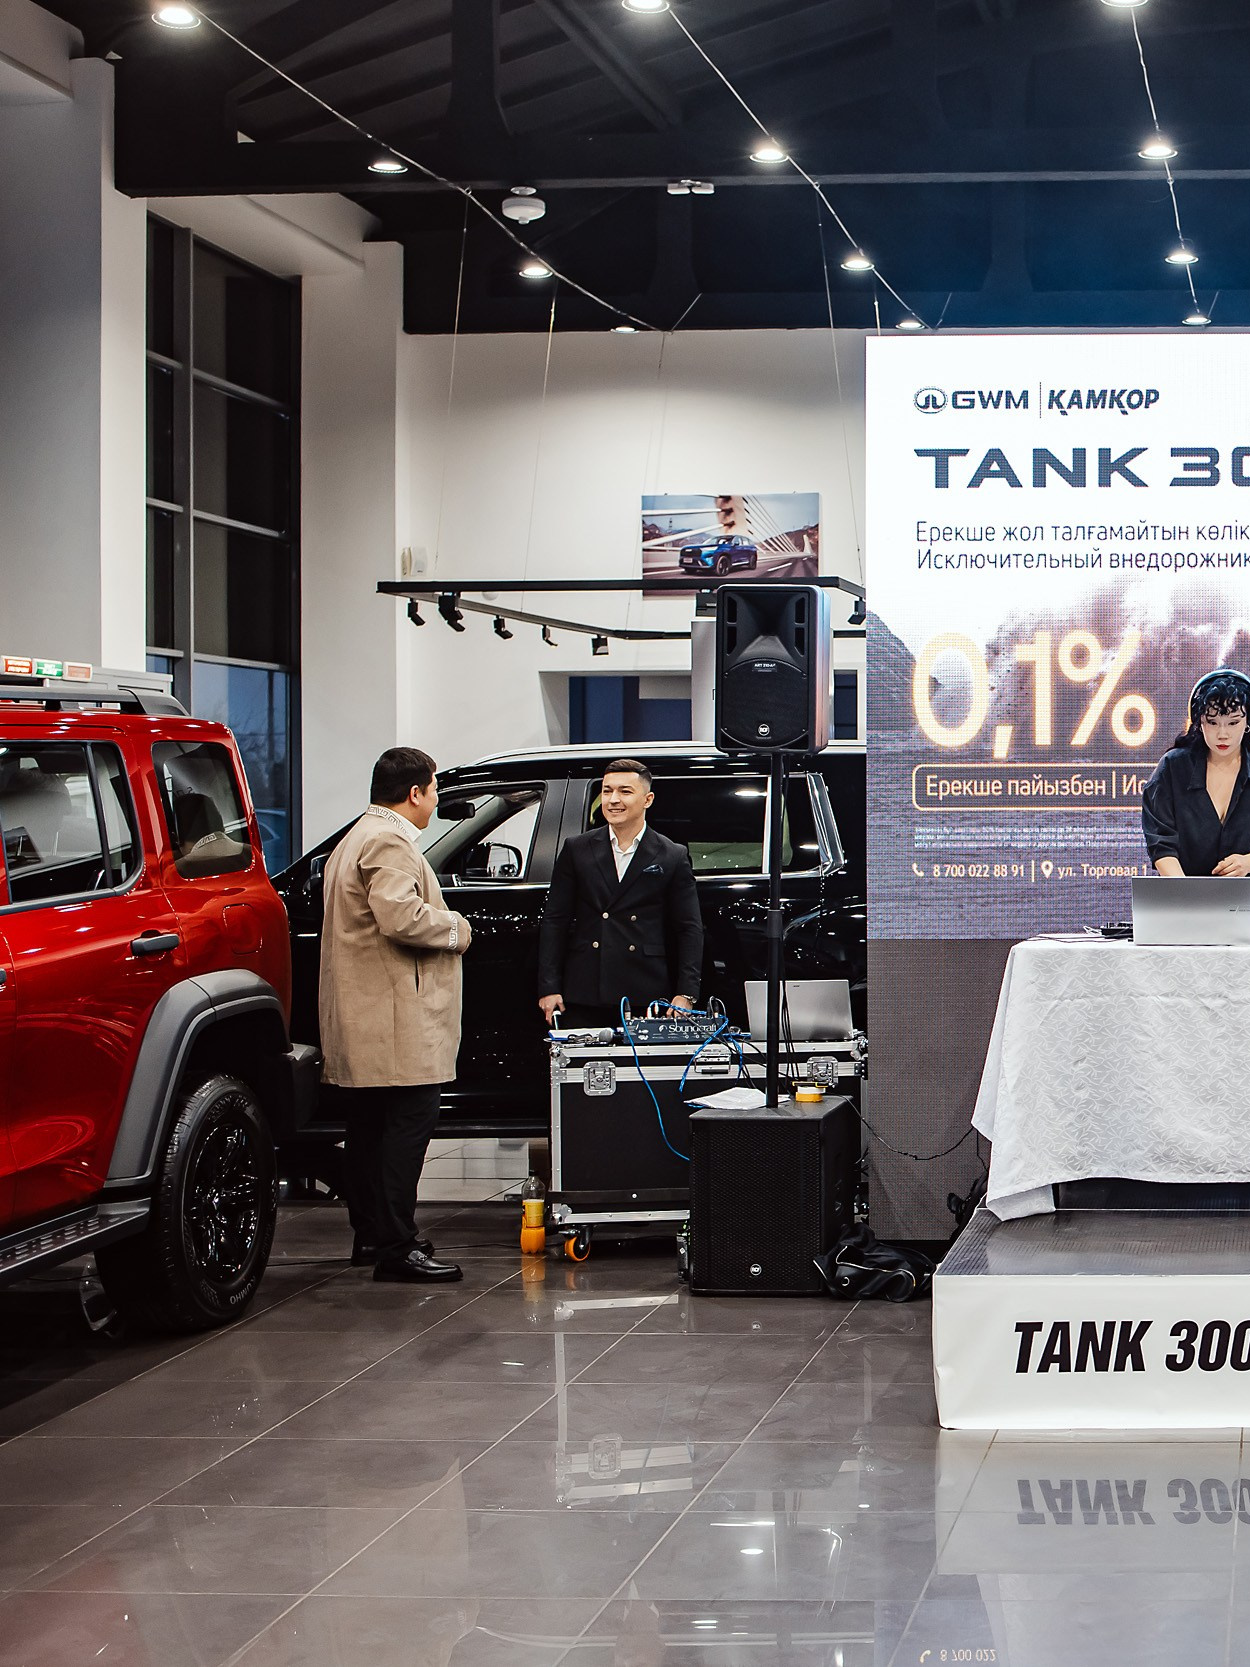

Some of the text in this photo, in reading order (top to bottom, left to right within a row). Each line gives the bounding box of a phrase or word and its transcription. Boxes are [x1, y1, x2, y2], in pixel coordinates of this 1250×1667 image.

[951, 389, 1029, 410] GWM
[913, 447, 1149, 489] TANK
[916, 519, 1250, 546] Ерекше жол талғамайтын көлік
[917, 547, 1102, 570] Исключительный
[912, 629, 1157, 760] 0,1%
[926, 774, 1107, 800] Ерекше пайызбен
[933, 864, 1025, 878] 8 700 022 88 91
[1057, 866, 1076, 879] ул.
[1080, 863, 1139, 880] Торговая
[1014, 1320, 1154, 1374] TANK
